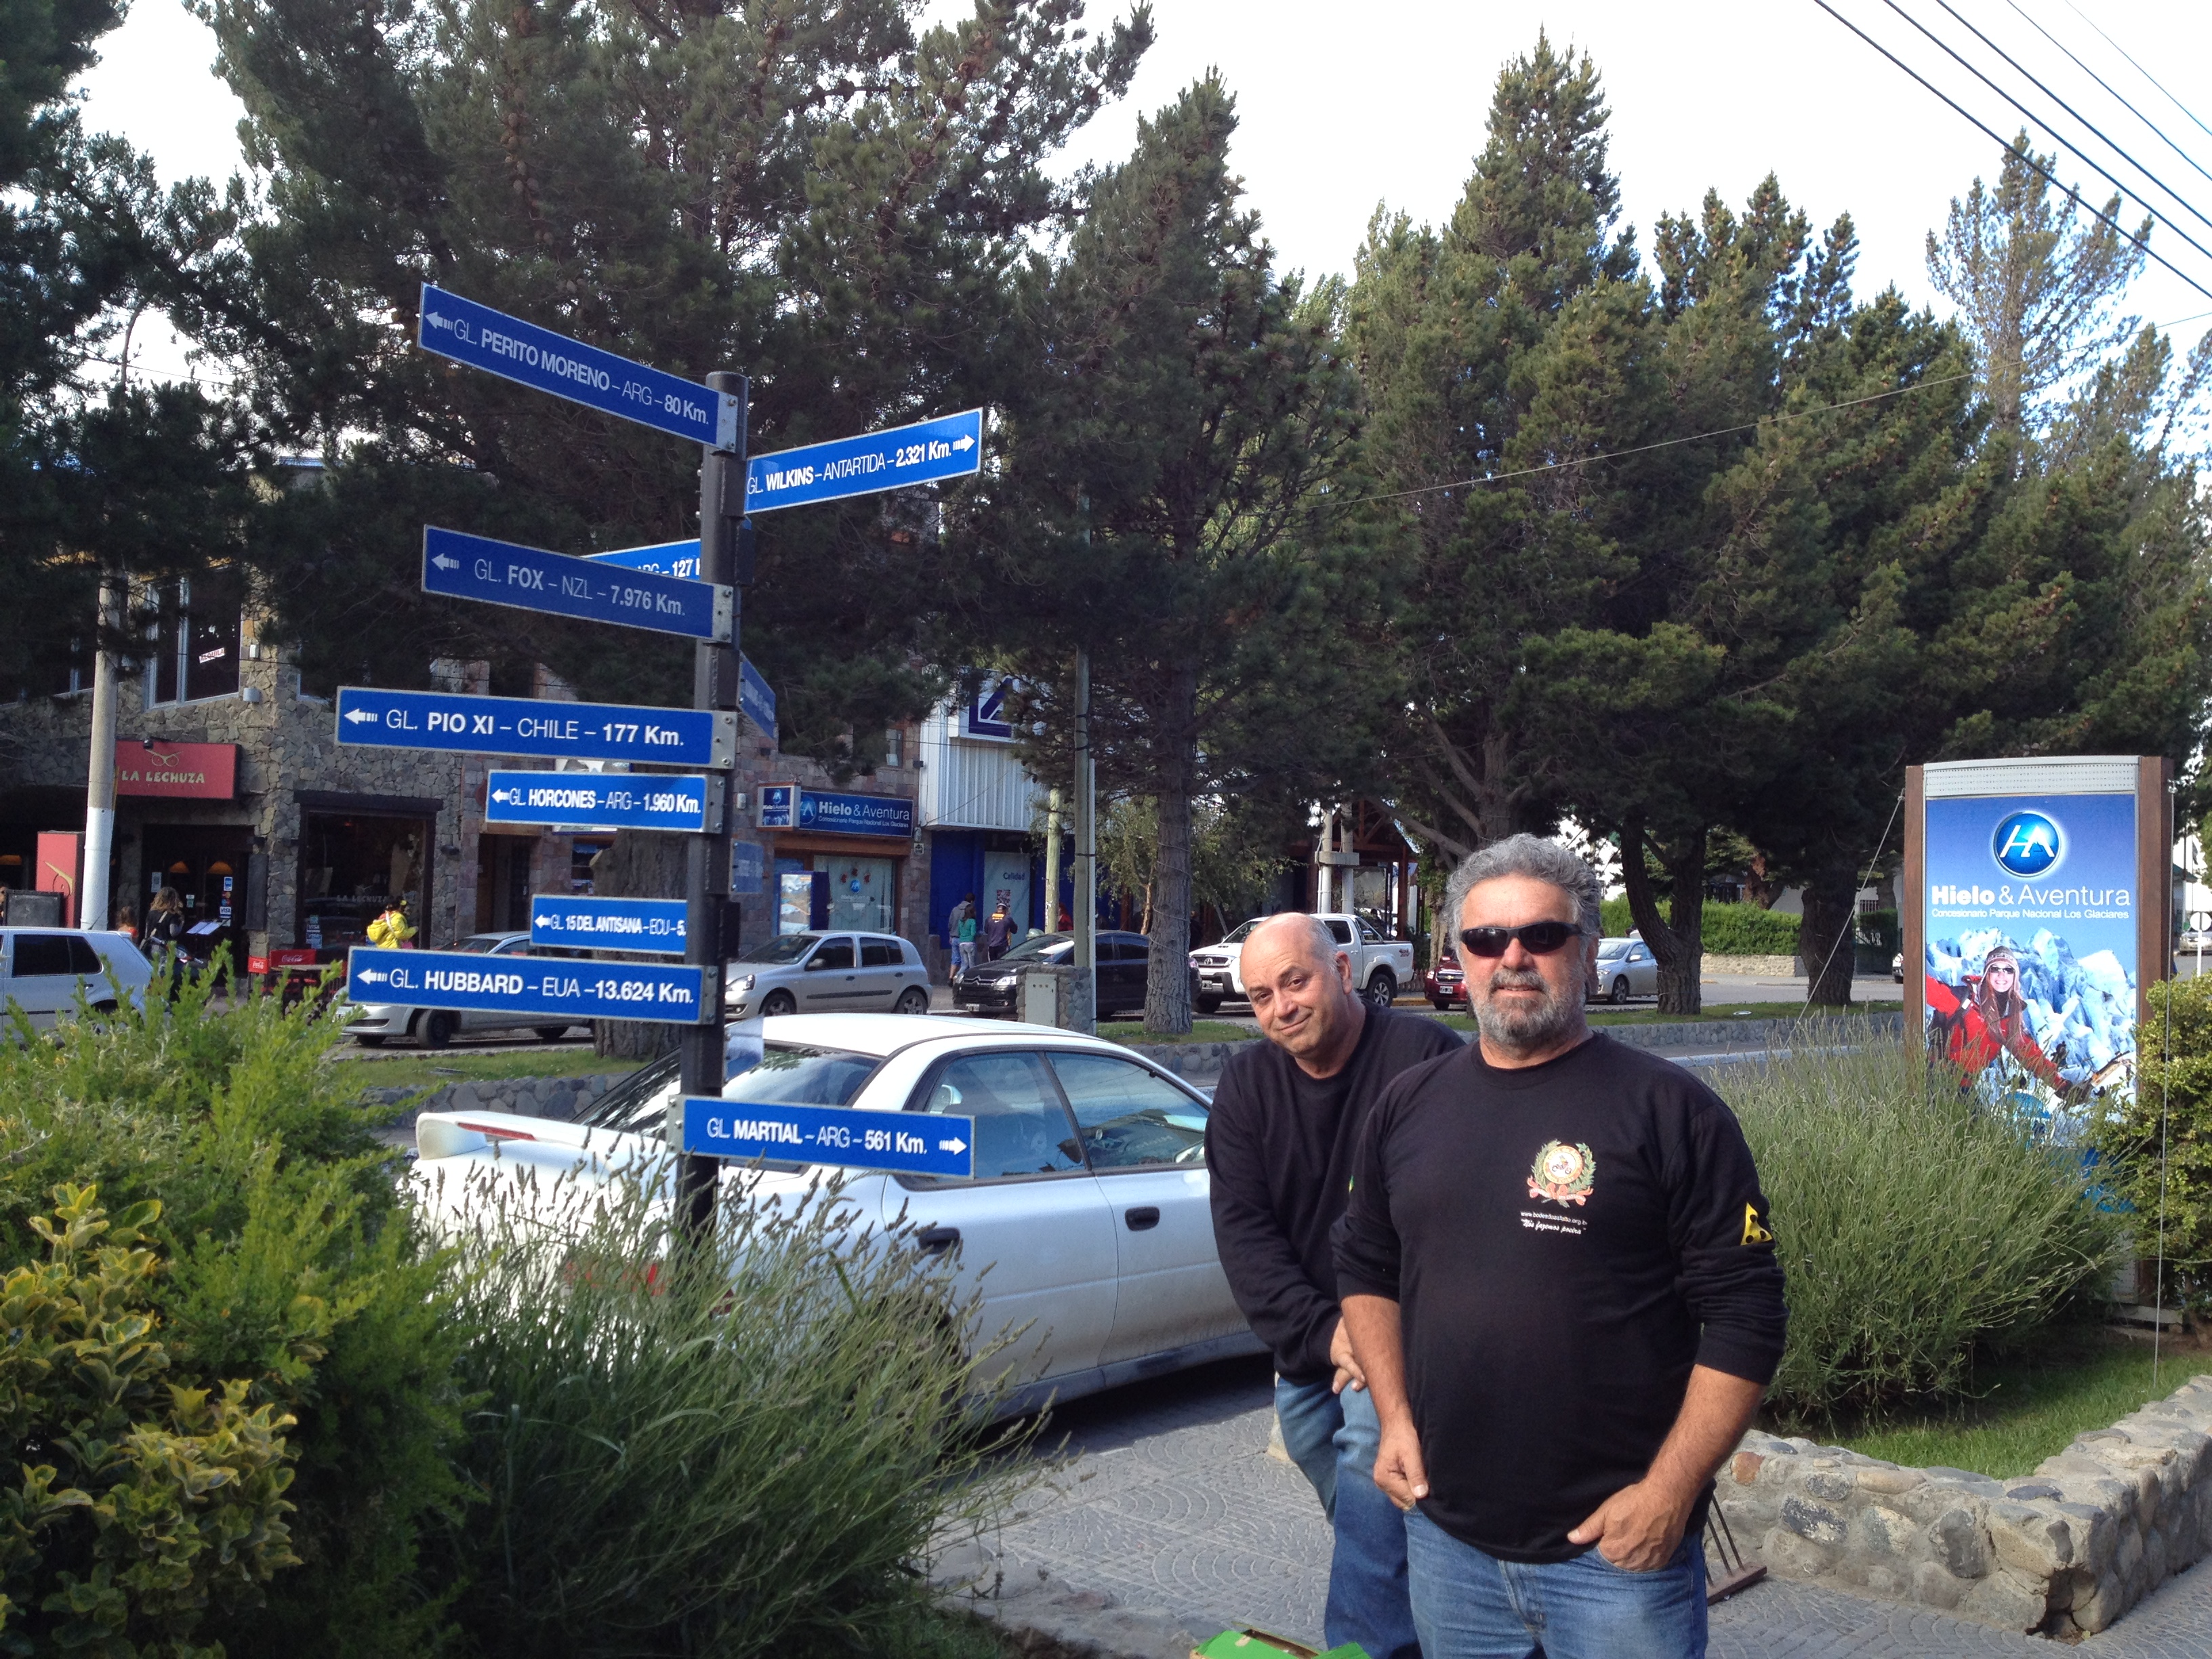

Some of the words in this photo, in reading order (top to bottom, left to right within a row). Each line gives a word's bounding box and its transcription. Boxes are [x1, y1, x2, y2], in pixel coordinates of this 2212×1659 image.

[481, 327, 539, 366] PERITO
[541, 350, 610, 391] MORENO
[622, 381, 653, 406] ARG
[664, 394, 682, 415] 80
[683, 400, 709, 425] Km.
[766, 466, 815, 491] WILKINS
[823, 452, 886, 481] ANTARTIDA
[895, 443, 926, 468] 2.321
[928, 440, 951, 461] Km.
[672, 558, 693, 577] 127
[508, 565, 544, 591] FOX
[562, 575, 594, 600] NZL
[611, 585, 653, 610] 7.976
[656, 593, 686, 616] Km.
[386, 709, 418, 730] GL.
[427, 712, 467, 733] PIO
[472, 714, 494, 735] XI
[517, 718, 579, 740] CHILE
[602, 723, 639, 743] 177
[644, 725, 684, 746] Km.
[122, 770, 140, 781] LA
[146, 771, 205, 783] LECHUZA
[528, 788, 596, 809] HORCONES
[605, 792, 632, 811] ARG
[643, 793, 676, 813] 1.960
[676, 794, 701, 814] Km.
[818, 801, 852, 816] Hielo
[853, 804, 861, 817] &
[862, 804, 910, 821] Aventura
[1931, 885, 1995, 905] Hielo
[1999, 885, 2014, 905] &
[2018, 884, 2131, 906] Aventura
[565, 915, 576, 930] 15
[576, 915, 595, 931] DEL
[595, 916, 643, 935] ANTISANA
[649, 918, 671, 935] ECU
[1931, 908, 1988, 918] Concesionario
[1989, 909, 2021, 920] Parque
[2022, 909, 2062, 919] Nacional
[2064, 909, 2082, 919] Los
[2084, 909, 2129, 920] Glaciares
[390, 968, 419, 989] GL.
[424, 970, 524, 995] HUBBARD
[542, 977, 581, 998] EUA
[659, 983, 694, 1004] Km.
[733, 1119, 804, 1145] MARTIAL
[817, 1126, 851, 1149] ARG
[865, 1129, 891, 1152] 561
[895, 1131, 928, 1155] Km.
